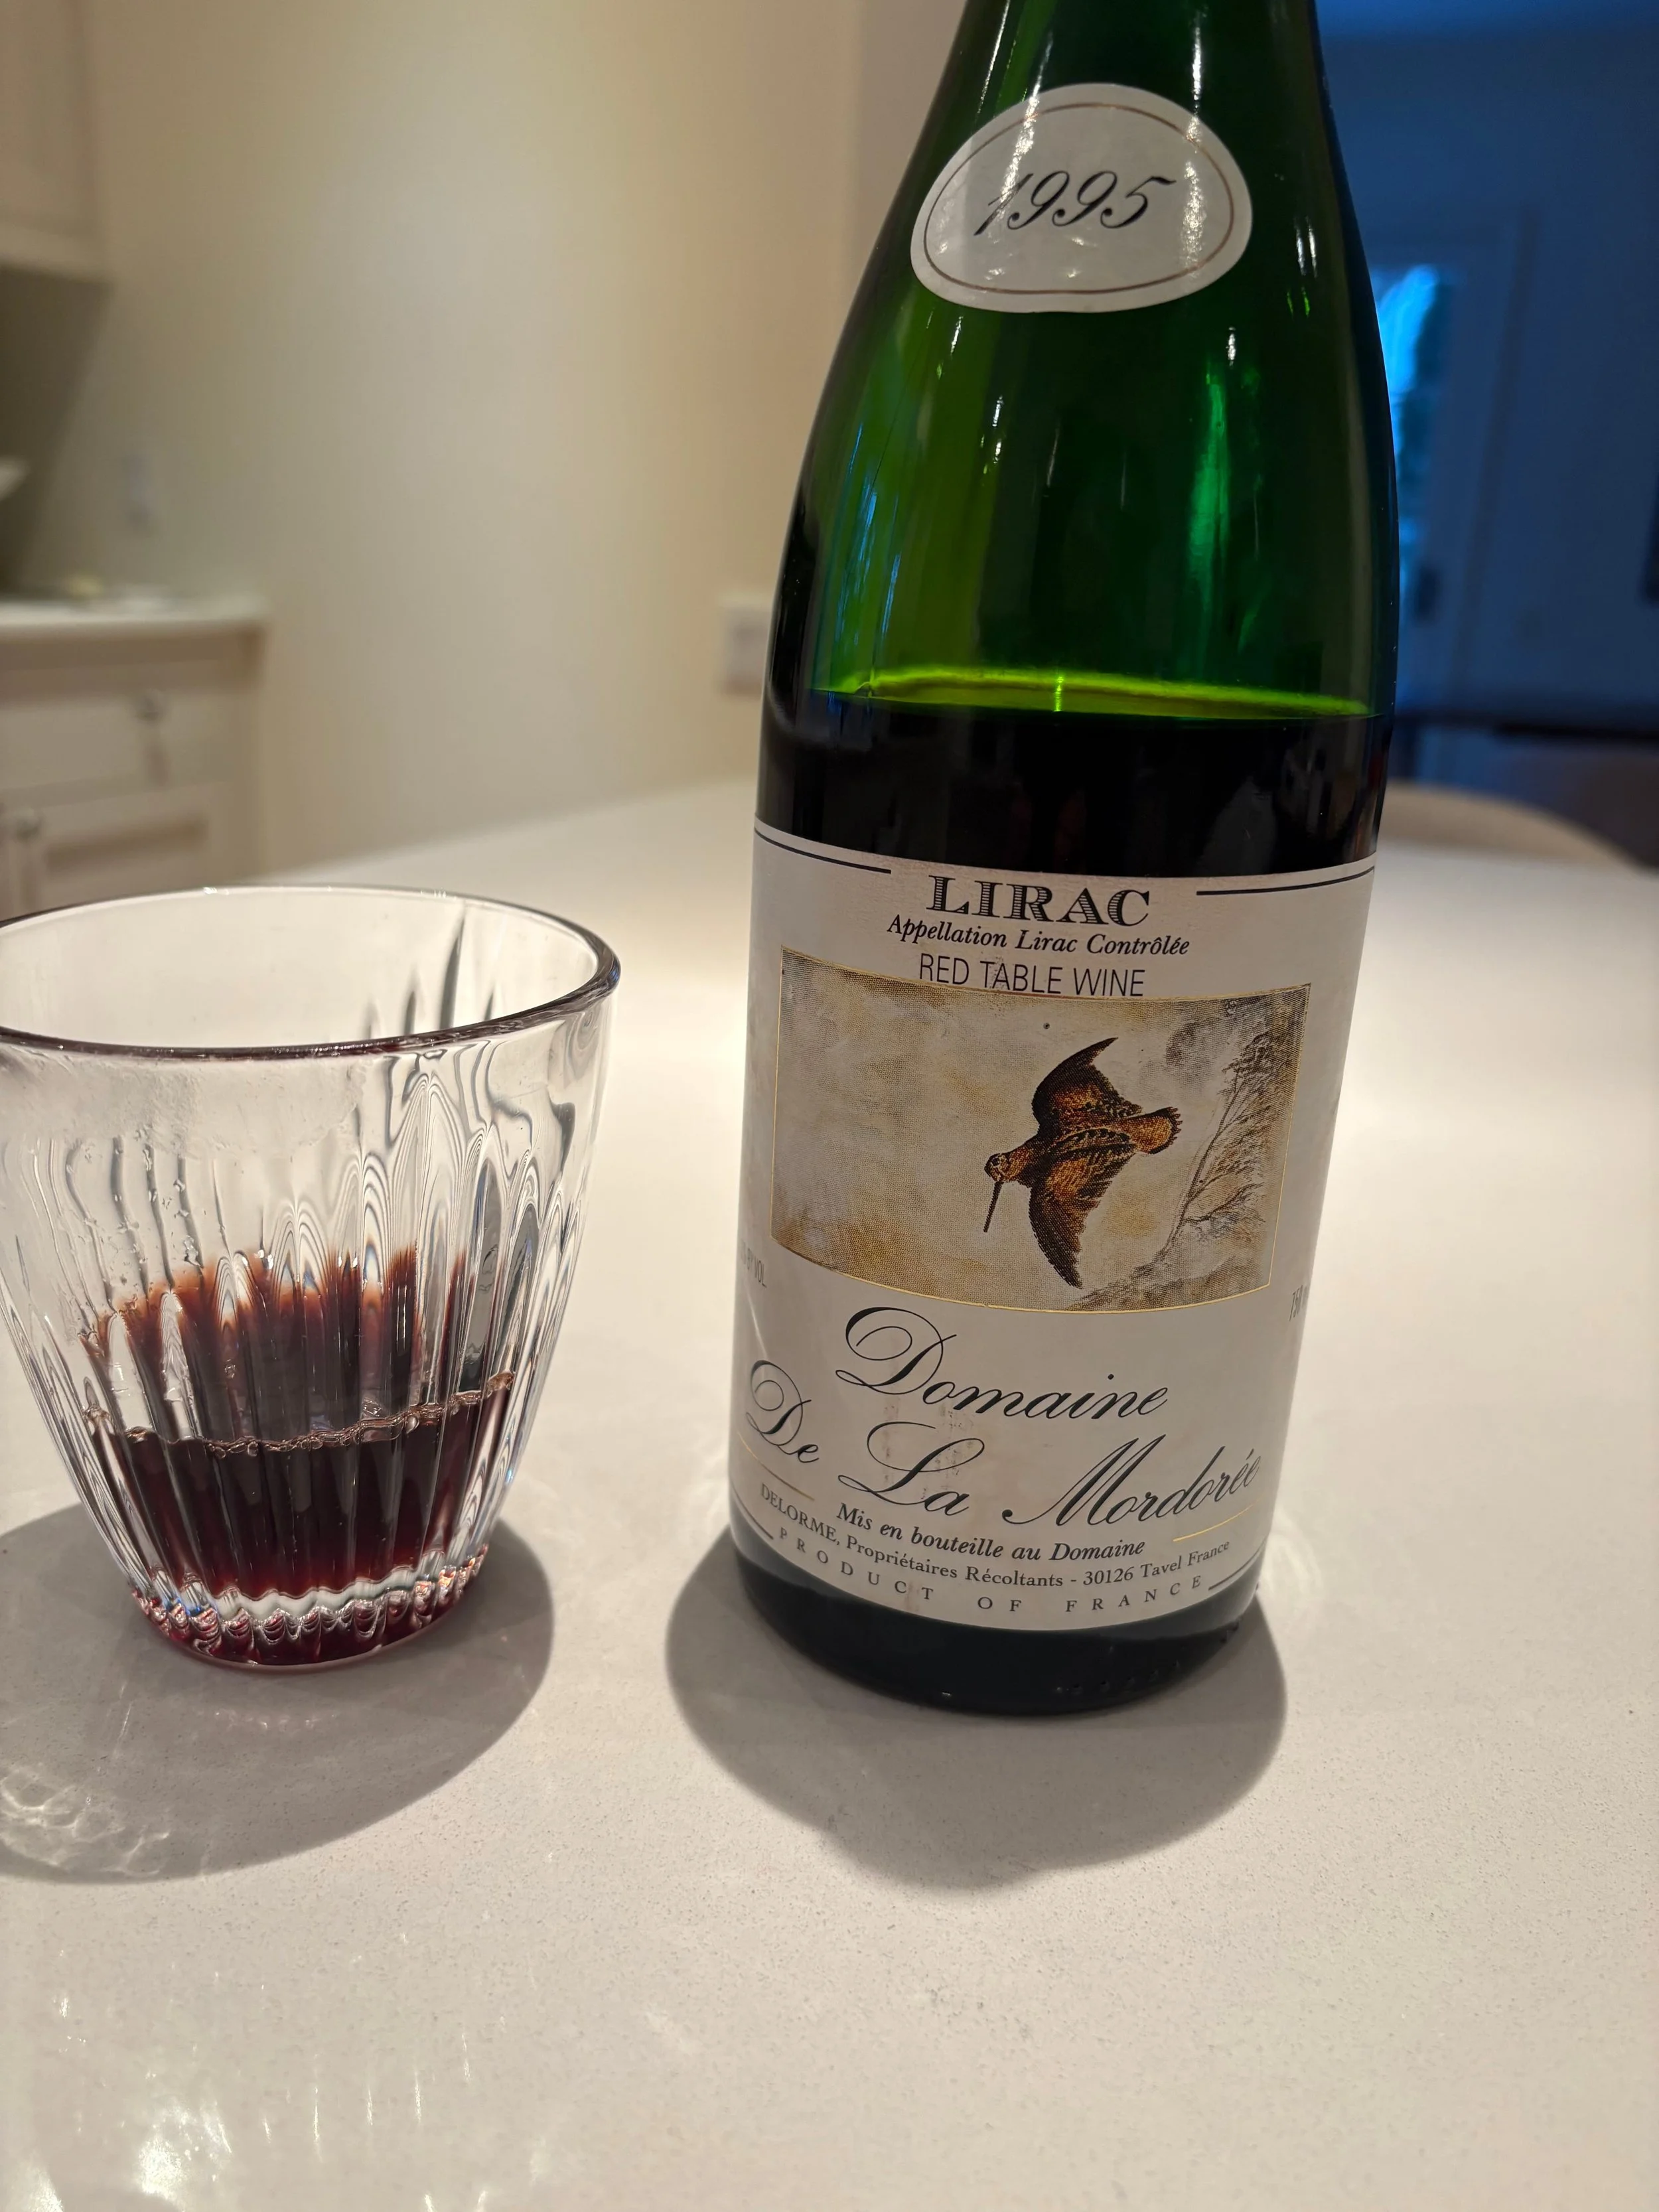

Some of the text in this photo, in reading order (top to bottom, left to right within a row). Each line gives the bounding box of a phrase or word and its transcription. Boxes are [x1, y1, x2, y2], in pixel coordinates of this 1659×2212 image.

[974, 171, 1177, 236] 1995
[926, 875, 1150, 926] LIRAC
[887, 913, 1190, 956] Appellation Lirac Contrôlée
[920, 953, 1146, 997] RED TABLE WINE
[835, 1306, 1169, 1419] Domaine
[746, 1360, 1262, 1526] De La Mordorée
[761, 1483, 840, 1546] DELORME,
[847, 1534, 958, 1581] Propriétaires
[966, 1565, 1064, 1587] Récoltants
[1083, 1566, 1134, 1585] 30126
[1140, 1556, 1183, 1578] Tavel
[1188, 1540, 1230, 1566] France
[836, 1503, 1146, 1561] Mis en bouteille au Domaine
[780, 1527, 1202, 1613] PRODUCT OF FRANCE
